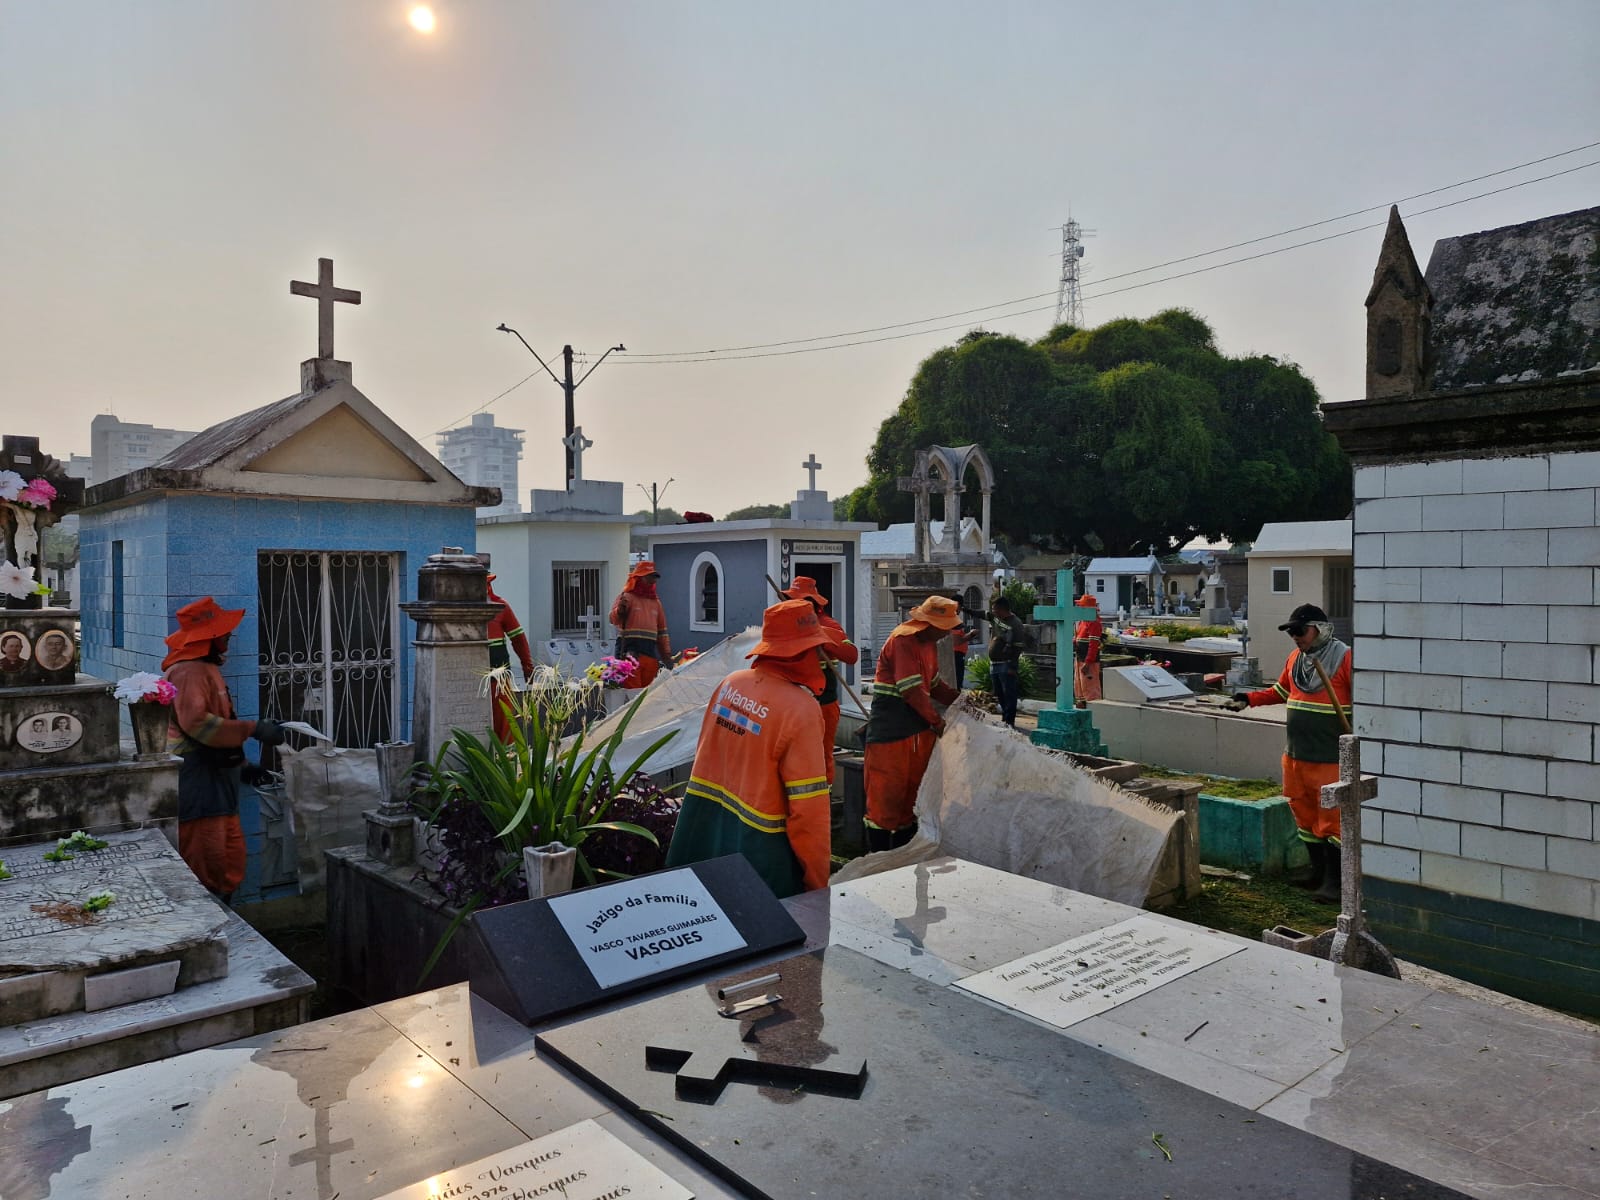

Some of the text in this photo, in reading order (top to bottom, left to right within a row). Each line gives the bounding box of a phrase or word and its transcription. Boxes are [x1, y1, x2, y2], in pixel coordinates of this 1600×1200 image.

[725, 686, 769, 719] Manaus
[586, 894, 698, 934] Jazigo da Família
[590, 939, 624, 953] VASCO
[626, 927, 667, 944] TAVARES
[625, 930, 703, 961] VASQUES
[478, 1148, 562, 1182] Vasques
